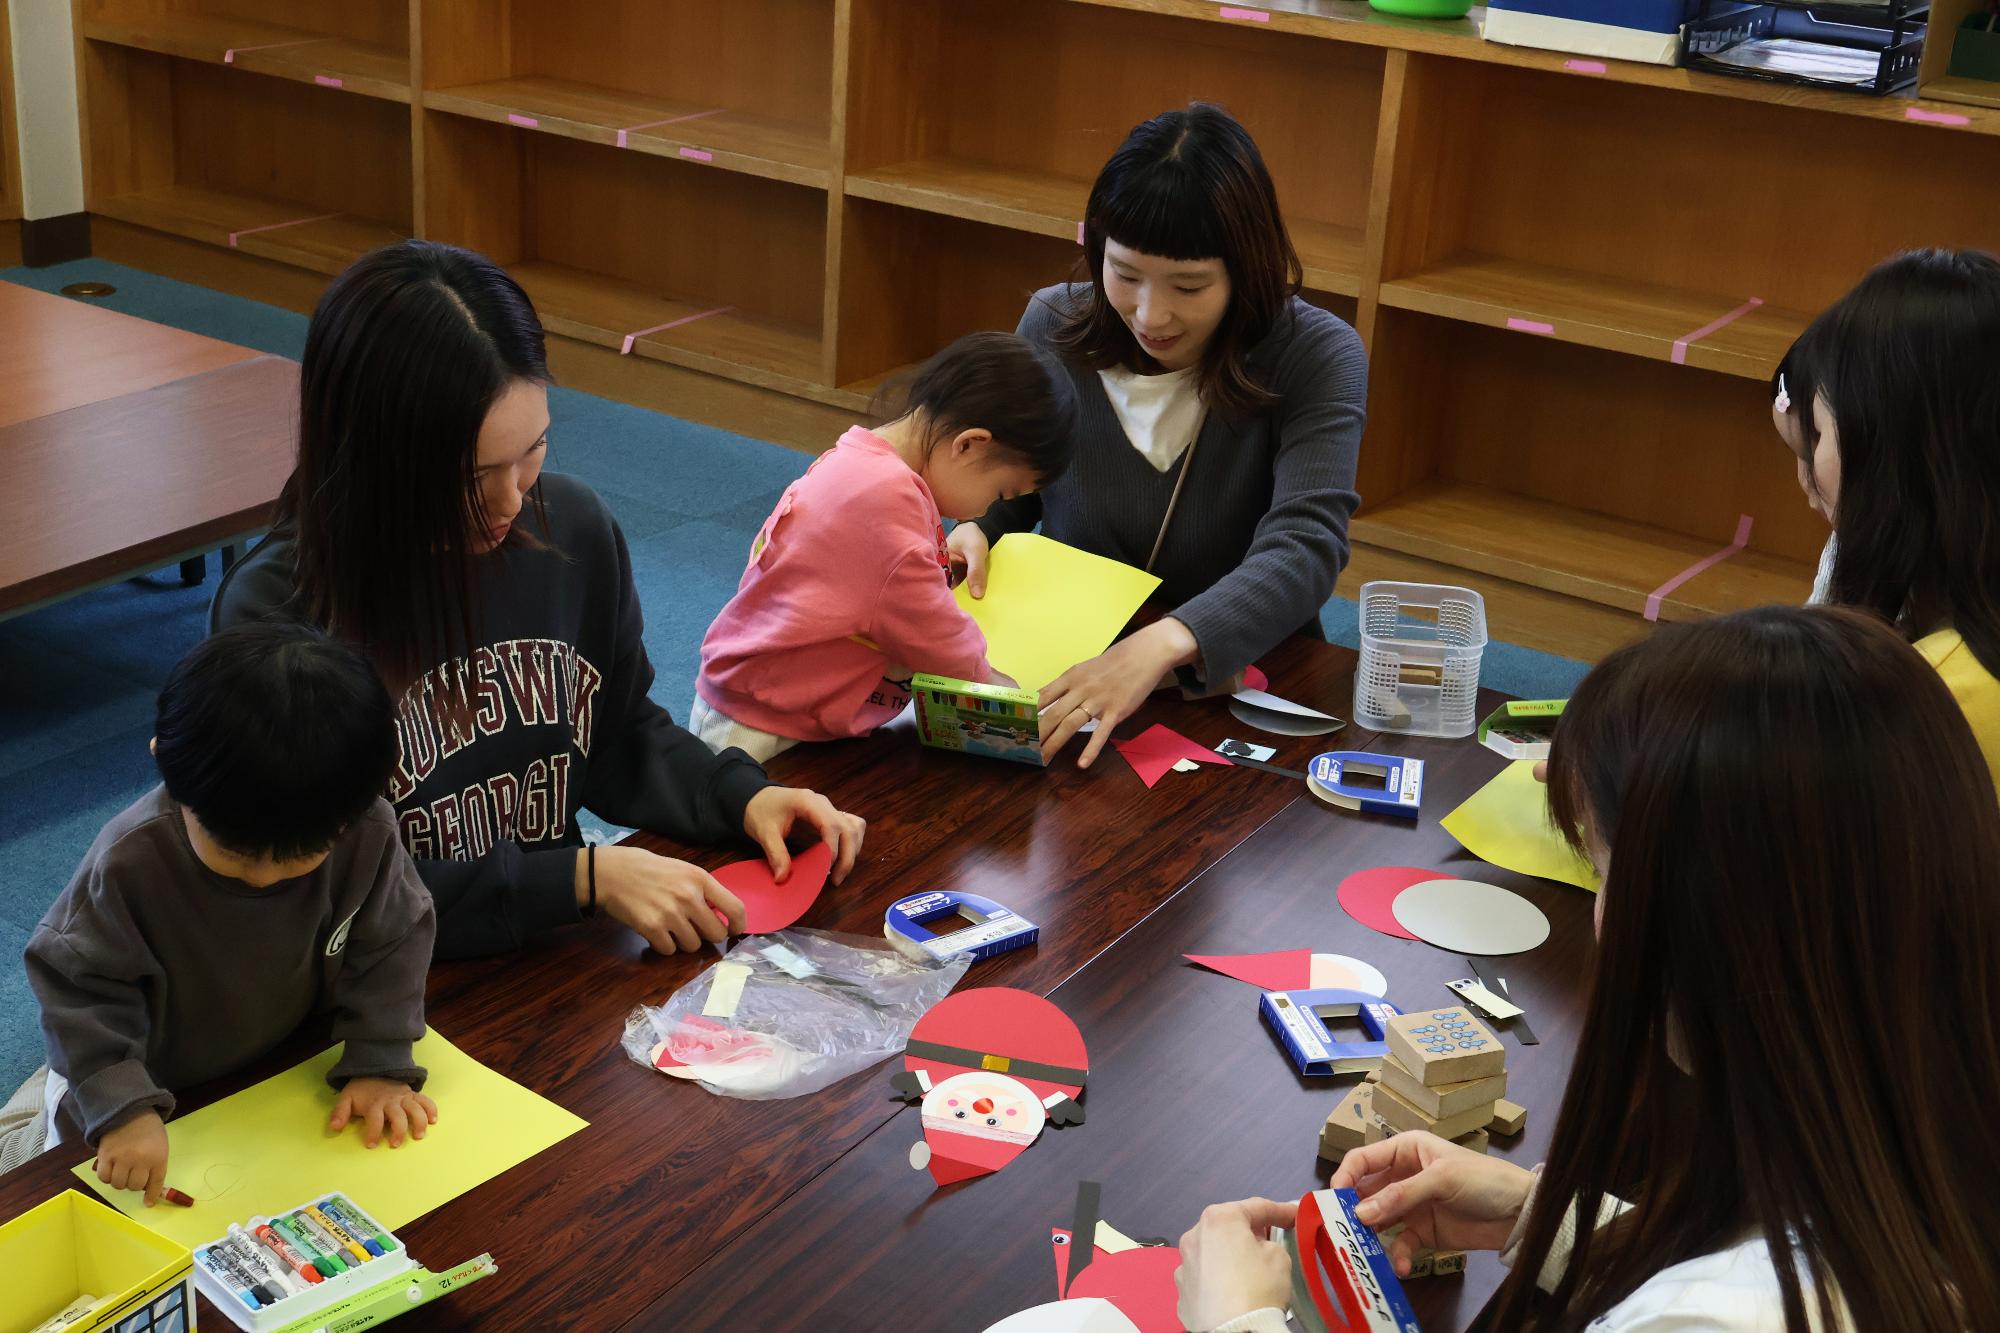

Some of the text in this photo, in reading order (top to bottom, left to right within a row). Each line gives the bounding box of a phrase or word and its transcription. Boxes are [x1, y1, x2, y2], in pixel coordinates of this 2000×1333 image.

[398, 752, 571, 862] GEORGI
[1335, 1220, 1392, 1322] ナイスタック
